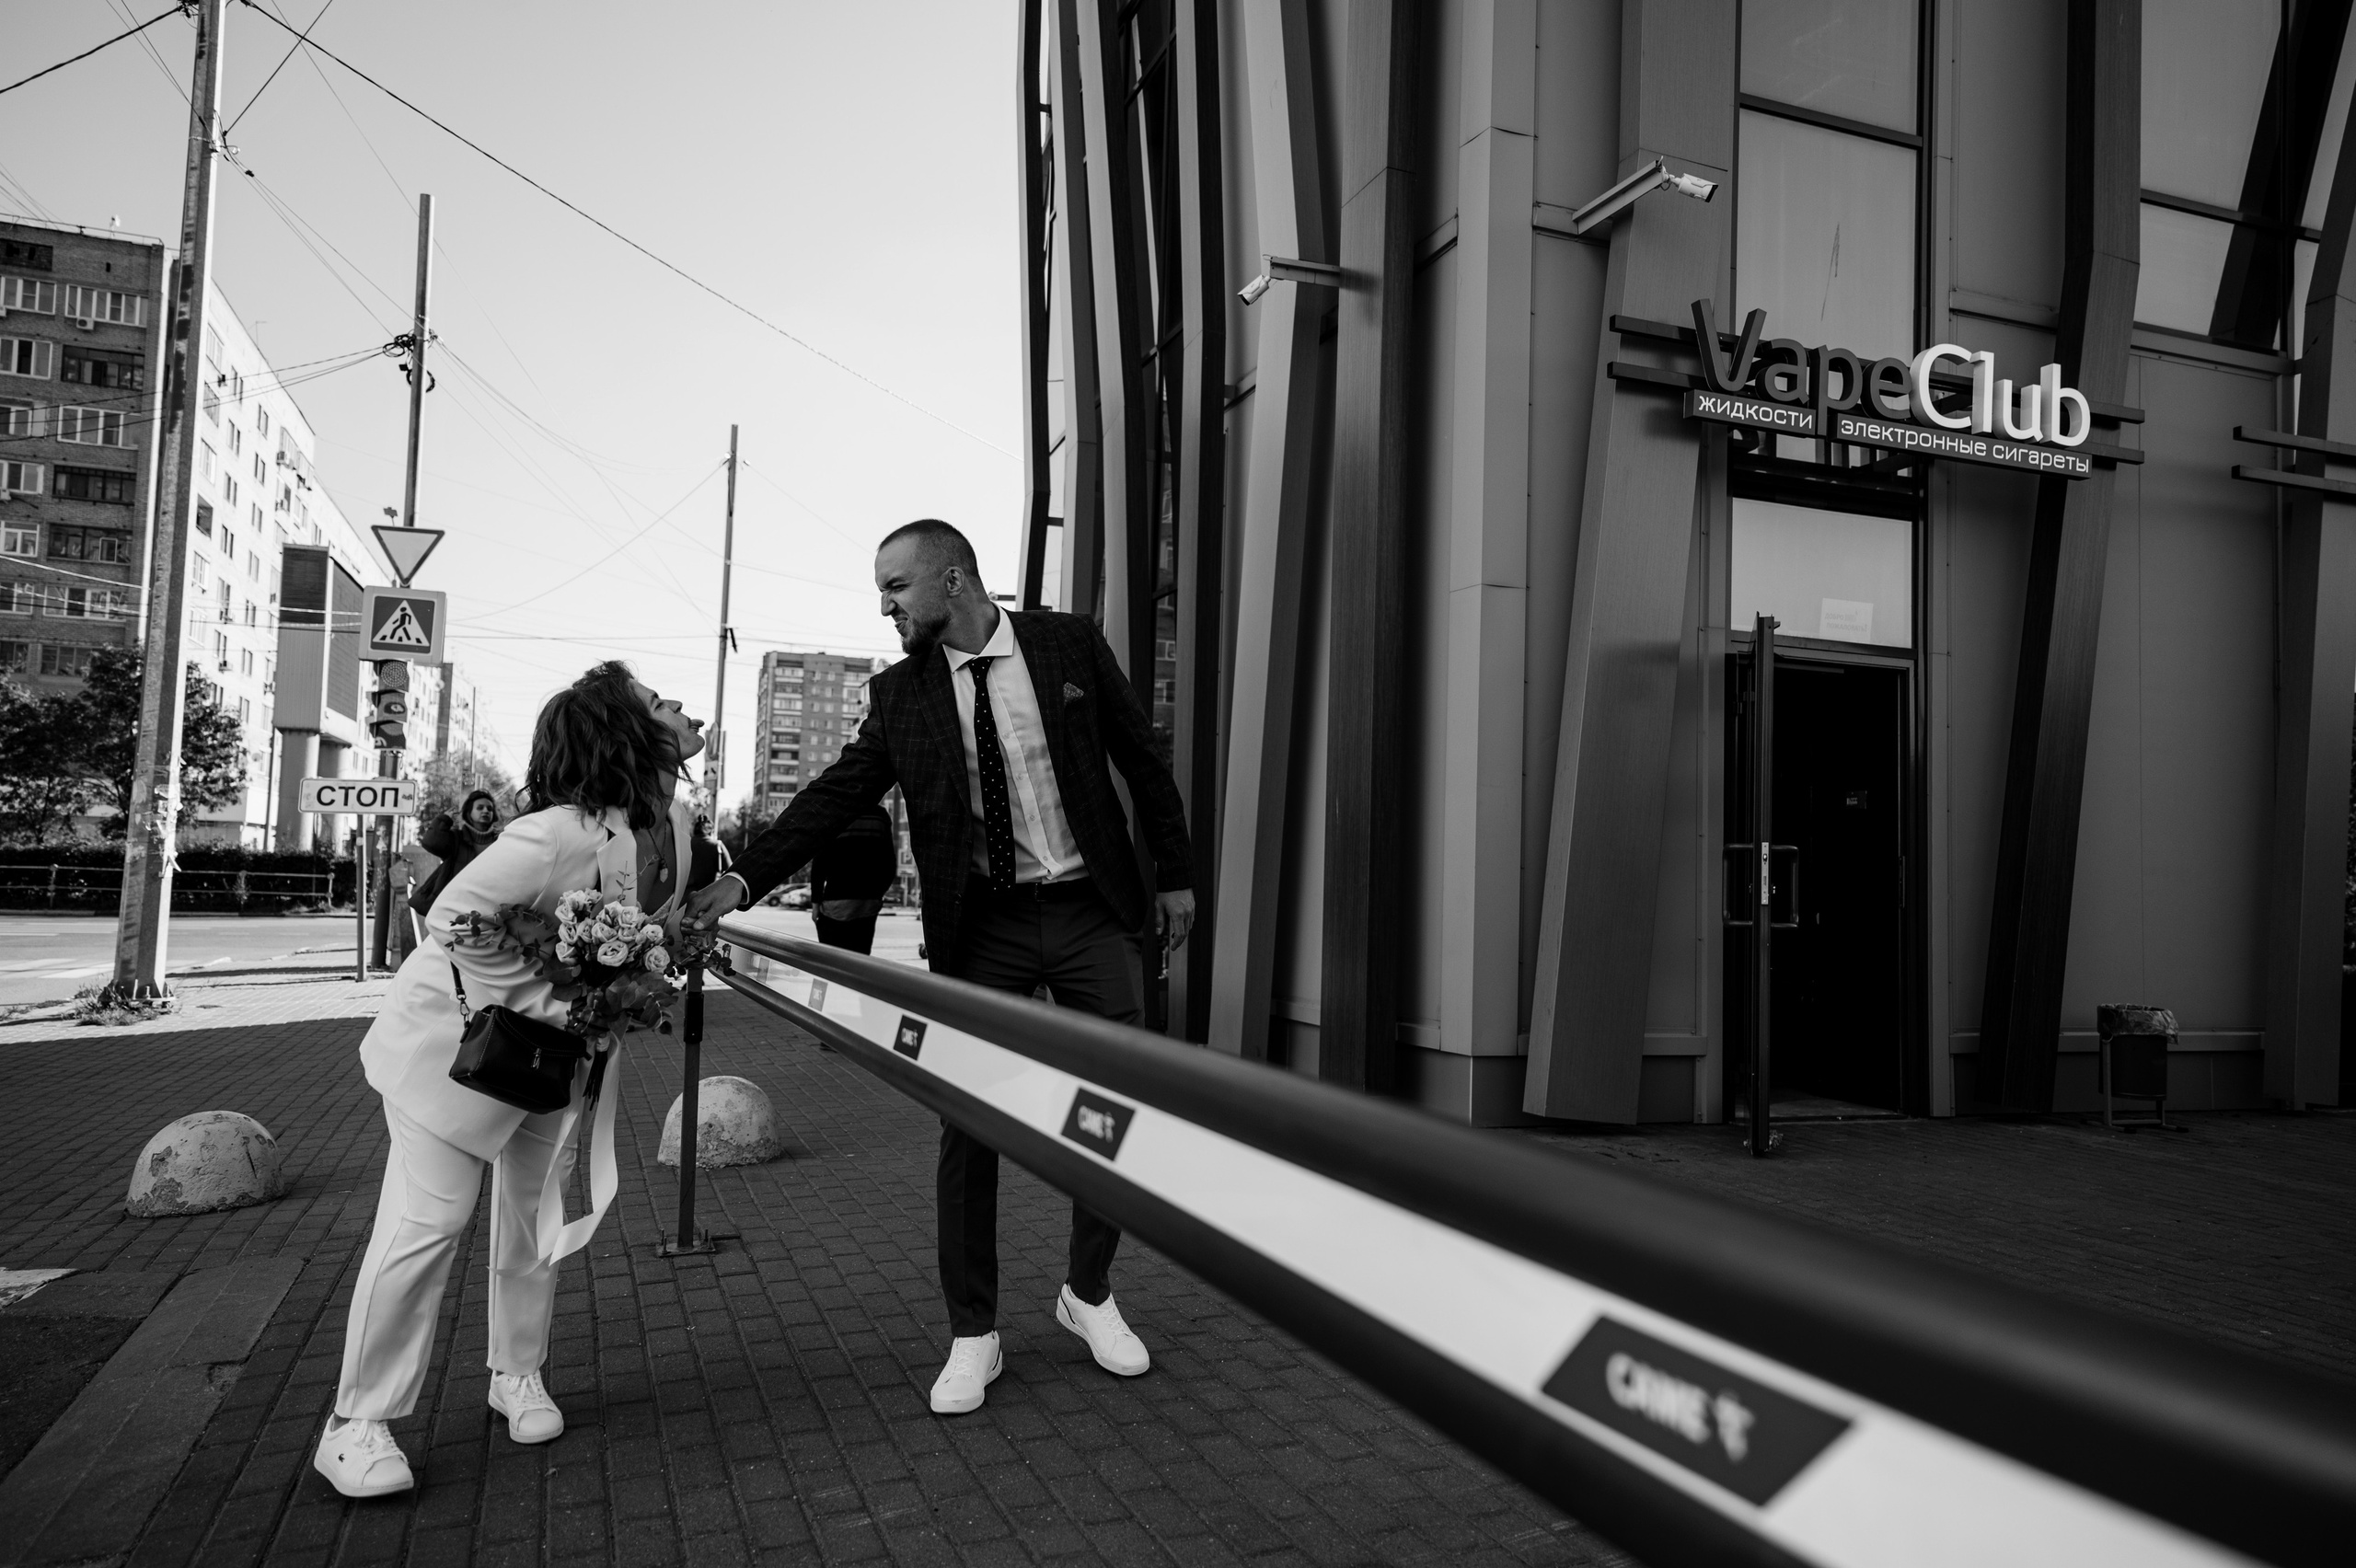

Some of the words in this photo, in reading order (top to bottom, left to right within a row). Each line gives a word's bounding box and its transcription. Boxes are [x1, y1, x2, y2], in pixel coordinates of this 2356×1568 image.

[1691, 298, 2091, 447] VapeClub
[1698, 395, 1813, 430] жидкости
[1841, 420, 1987, 456] электронные
[1992, 442, 2090, 474] сигареты
[317, 785, 399, 808] СТОП
